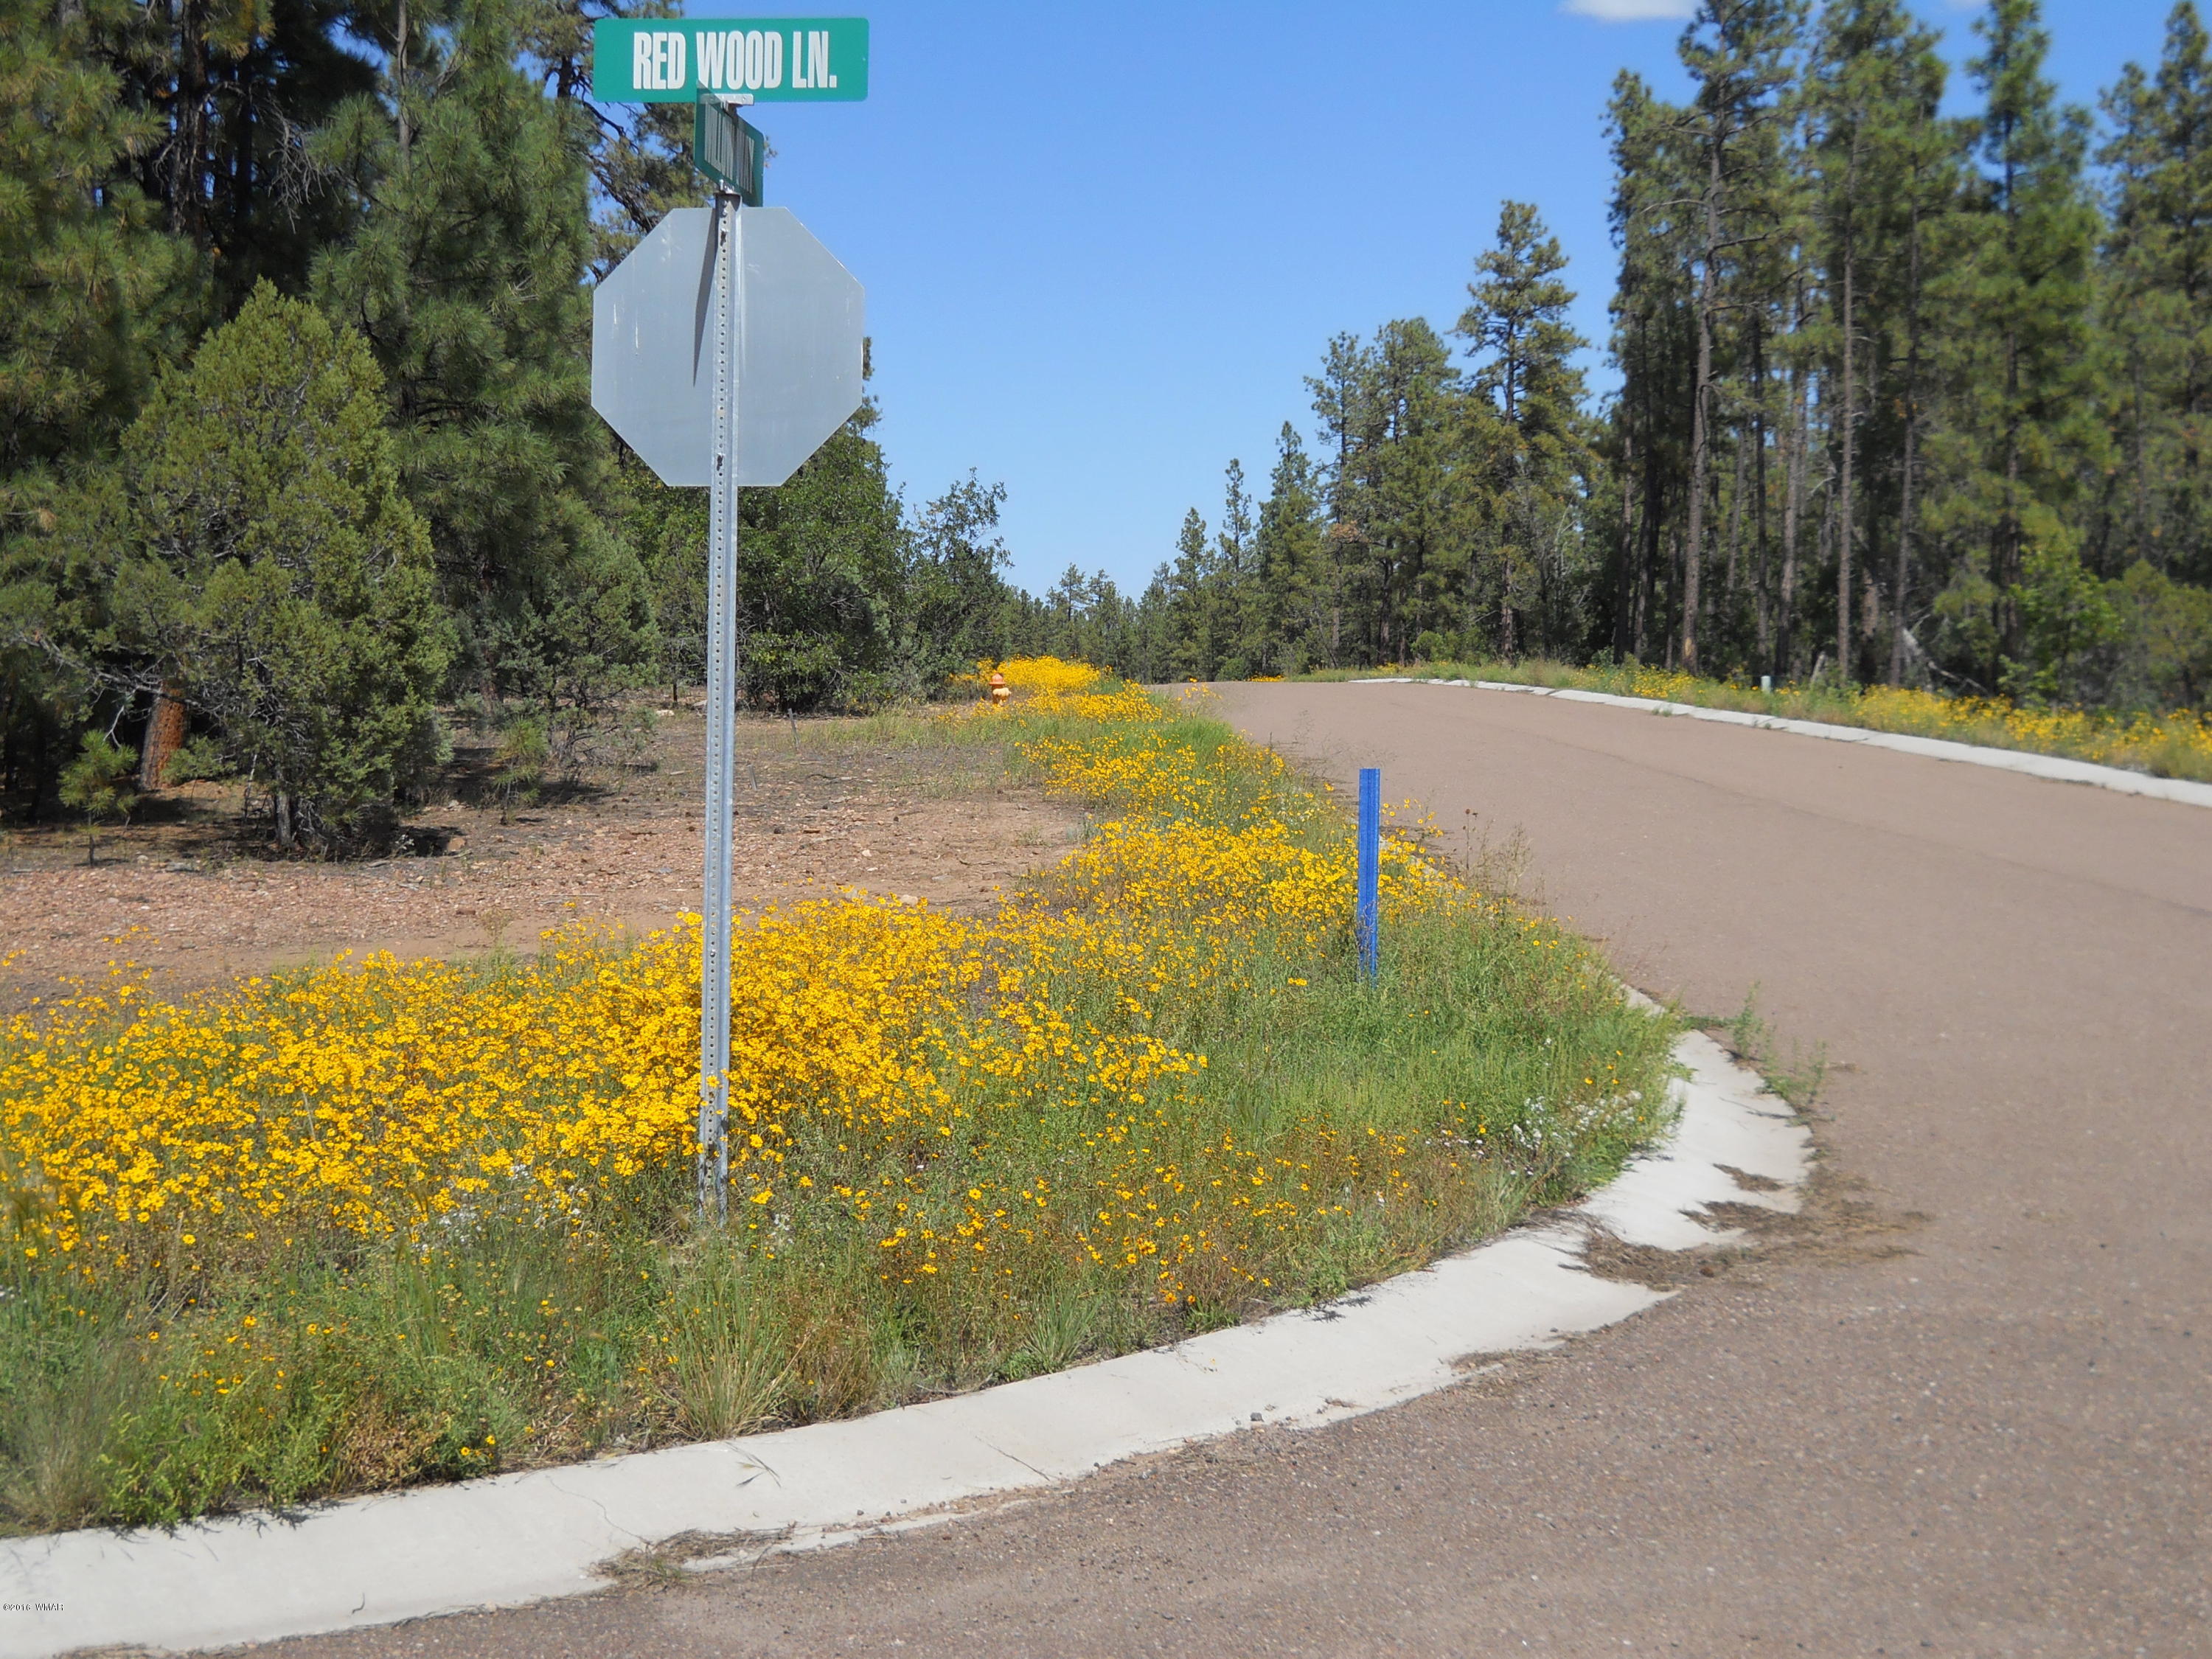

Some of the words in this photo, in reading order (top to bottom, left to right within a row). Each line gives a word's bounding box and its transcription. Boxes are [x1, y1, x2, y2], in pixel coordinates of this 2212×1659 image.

[633, 32, 686, 90] RED
[695, 30, 782, 90] WOOD
[792, 30, 837, 88] LN.
